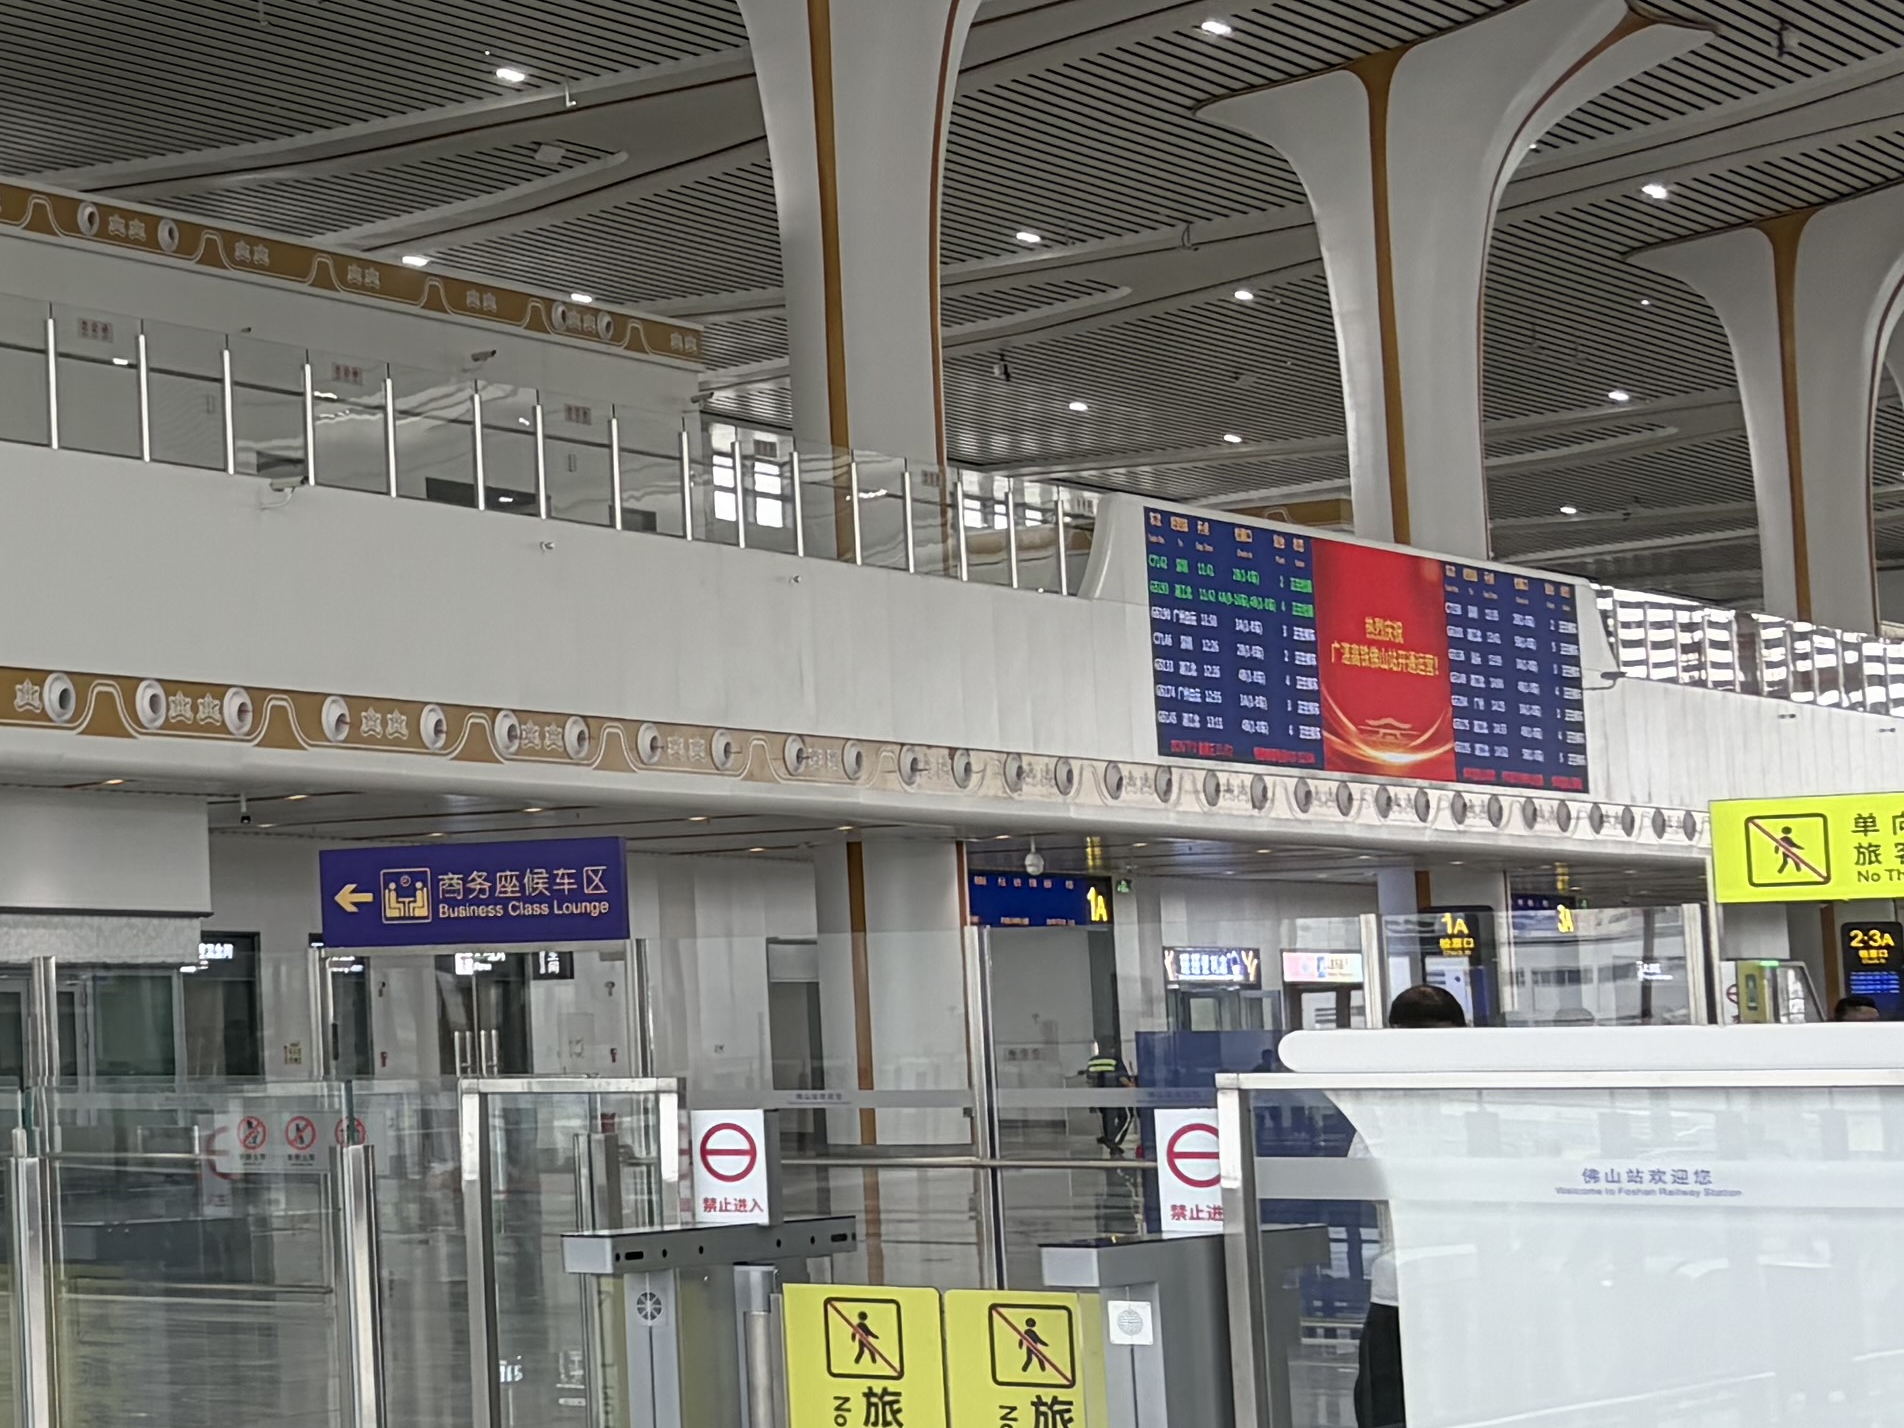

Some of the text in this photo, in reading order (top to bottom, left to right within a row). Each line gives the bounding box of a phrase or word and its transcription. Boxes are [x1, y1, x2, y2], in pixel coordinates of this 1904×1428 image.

[438, 866, 608, 900] 商务座候车区
[1857, 870, 1881, 882] No
[439, 900, 609, 918] Business Class Lounge
[1441, 912, 1469, 934] 1A
[1582, 1168, 1712, 1185] 佛山站欢迎您
[703, 1197, 763, 1214] 禁止进入
[833, 1395, 851, 1428] No
